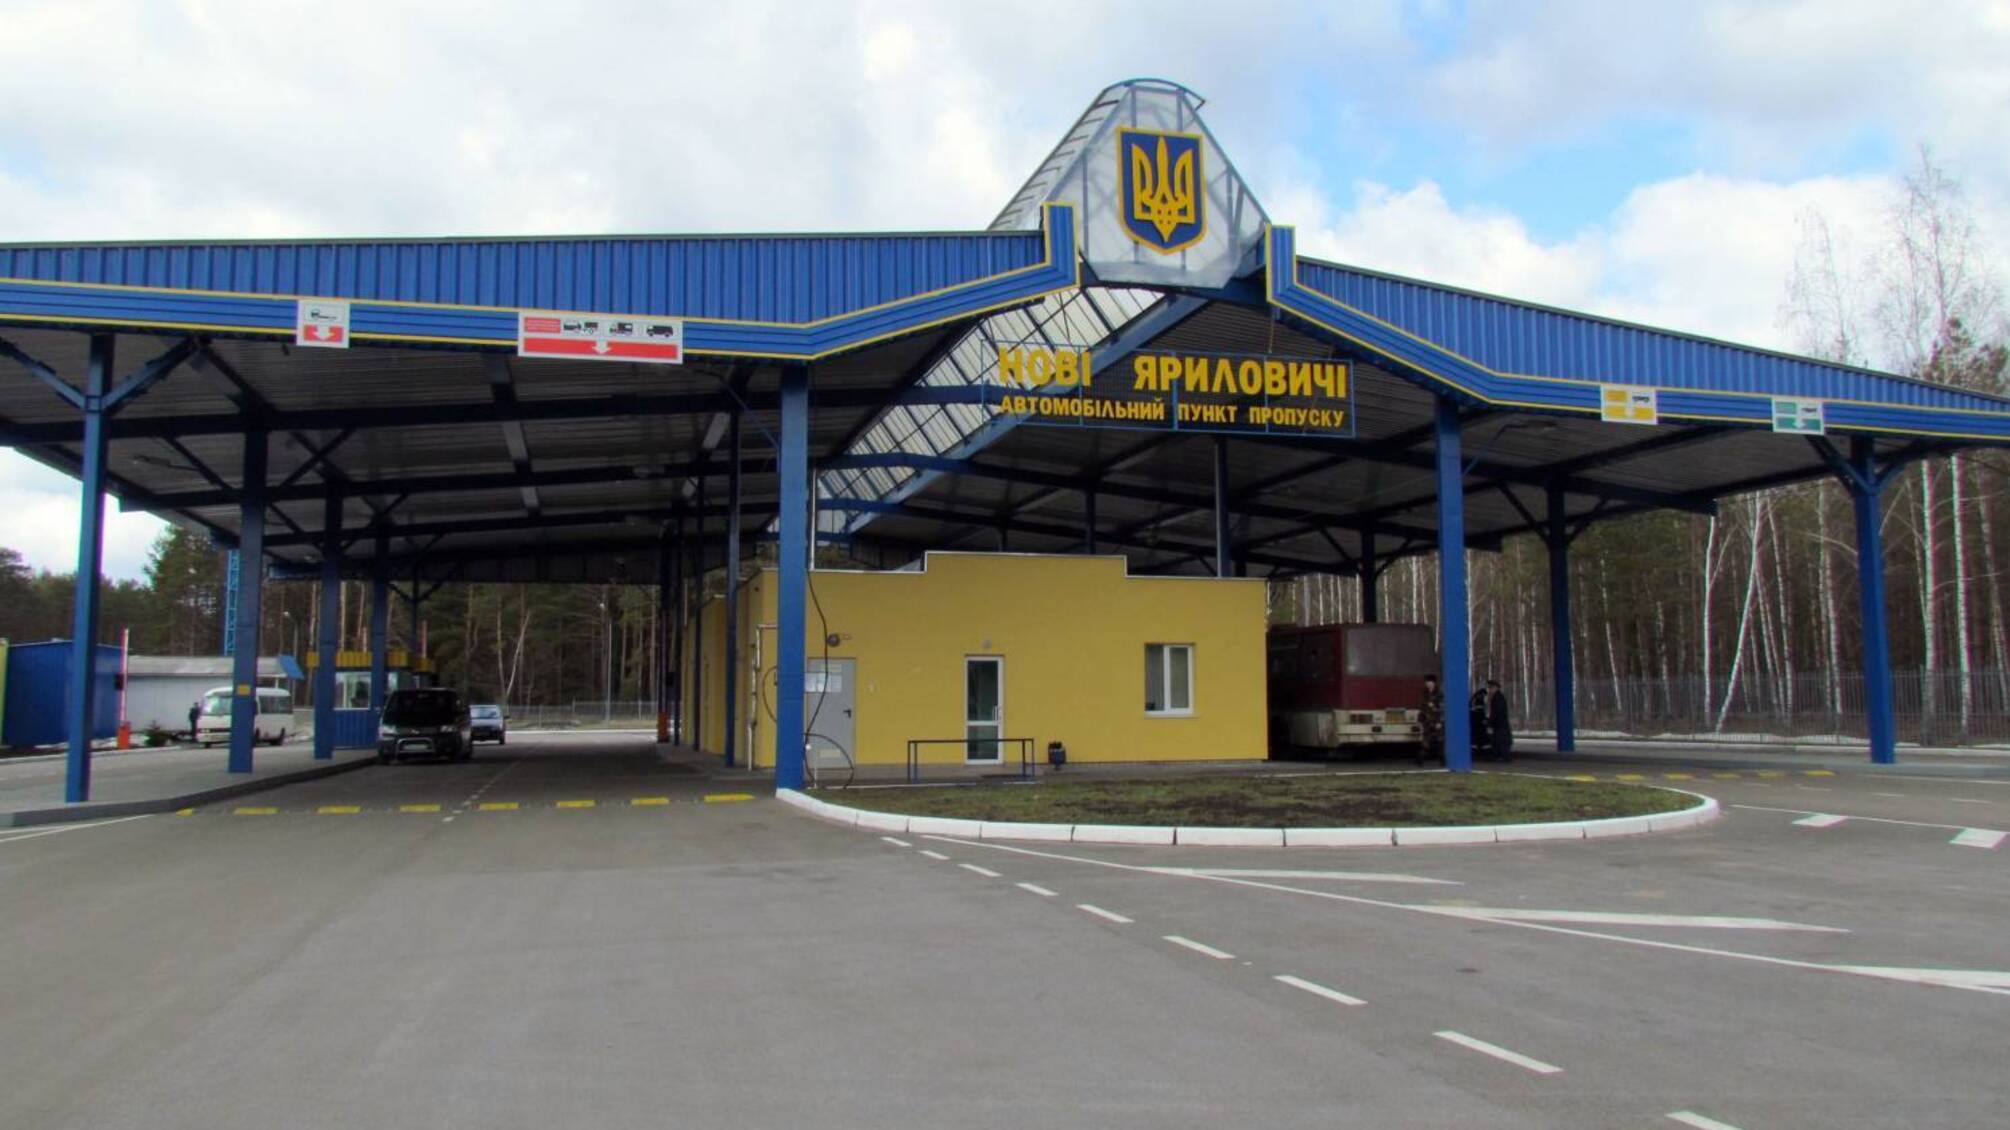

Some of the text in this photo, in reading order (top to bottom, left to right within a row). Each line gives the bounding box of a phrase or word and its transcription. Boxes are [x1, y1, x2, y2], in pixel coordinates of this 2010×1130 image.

[998, 347, 1347, 399] НОВІ ЯРИЛОВИЧІ
[999, 396, 1345, 428] АВТОМОБІЛЬНИЙ ПУНКТ ПРОПУСКУ
